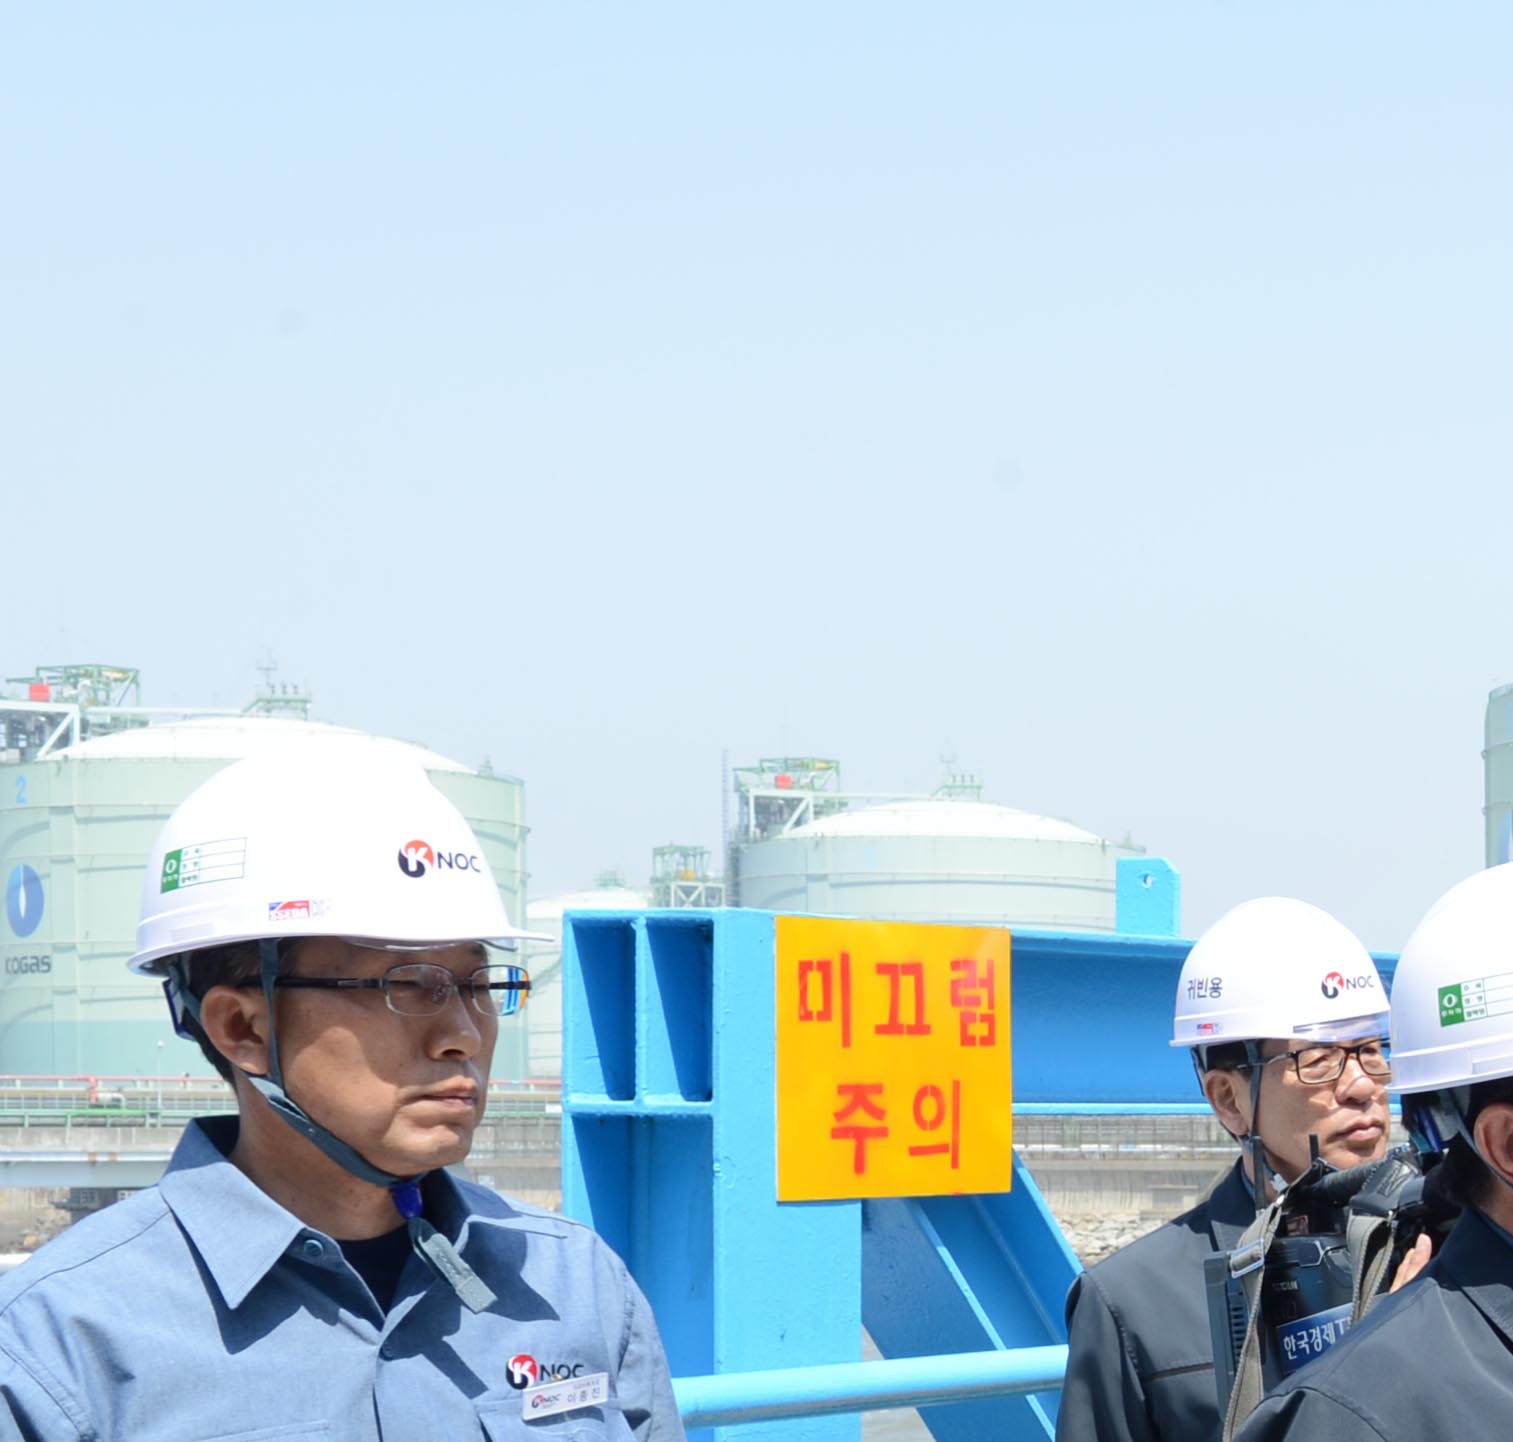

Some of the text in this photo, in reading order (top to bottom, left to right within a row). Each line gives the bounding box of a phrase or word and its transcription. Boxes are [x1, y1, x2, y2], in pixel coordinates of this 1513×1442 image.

[16, 776, 27, 803] 2
[397, 839, 481, 878] KNOC
[1187, 976, 1223, 1000] 귀빈용
[1321, 971, 1375, 1000] KNOC
[830, 1080, 960, 1175] 주의
[1283, 1317, 1351, 1360] 한국경제T
[505, 1353, 585, 1390] KNOC
